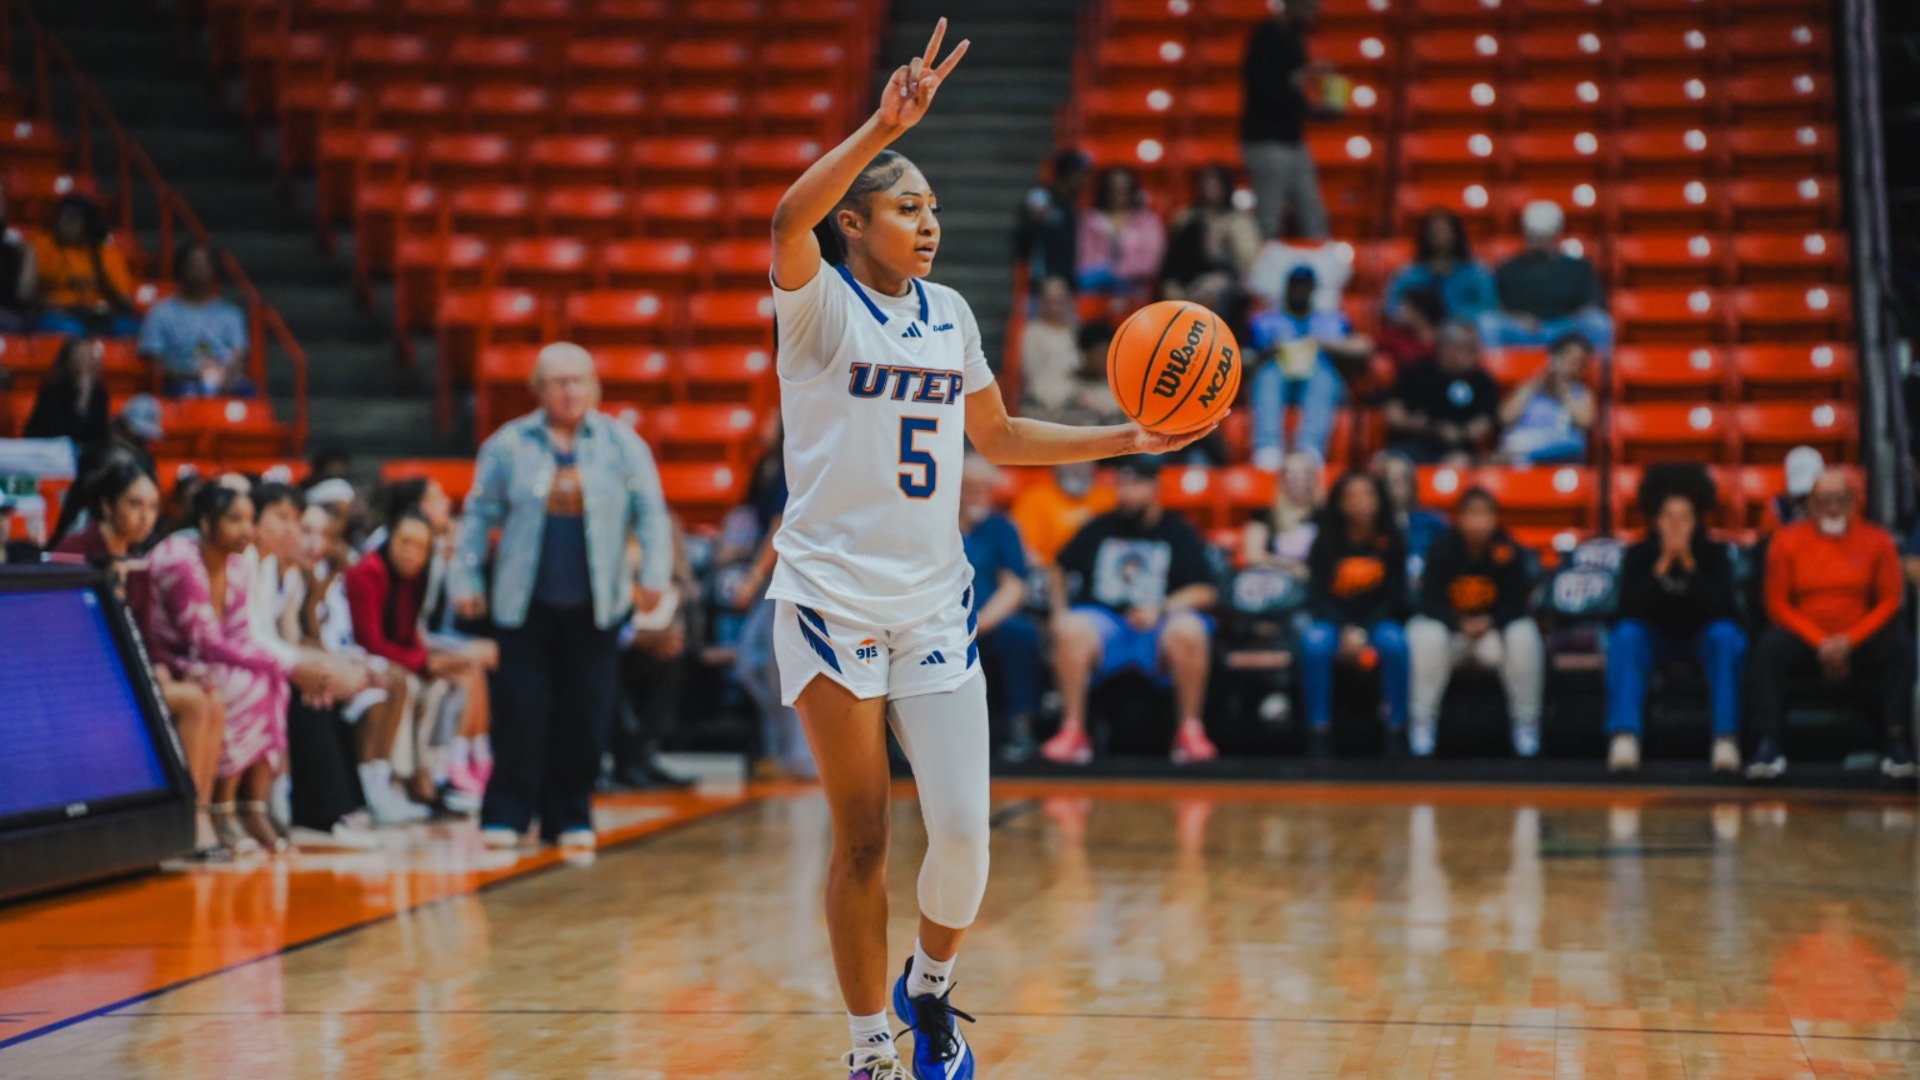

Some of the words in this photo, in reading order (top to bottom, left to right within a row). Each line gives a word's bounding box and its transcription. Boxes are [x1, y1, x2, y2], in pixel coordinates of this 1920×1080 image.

[848, 362, 963, 405] UTEP
[1152, 320, 1207, 398] Wilson
[1198, 345, 1233, 409] NCAA
[898, 415, 939, 501] 5
[855, 645, 878, 660] 915
